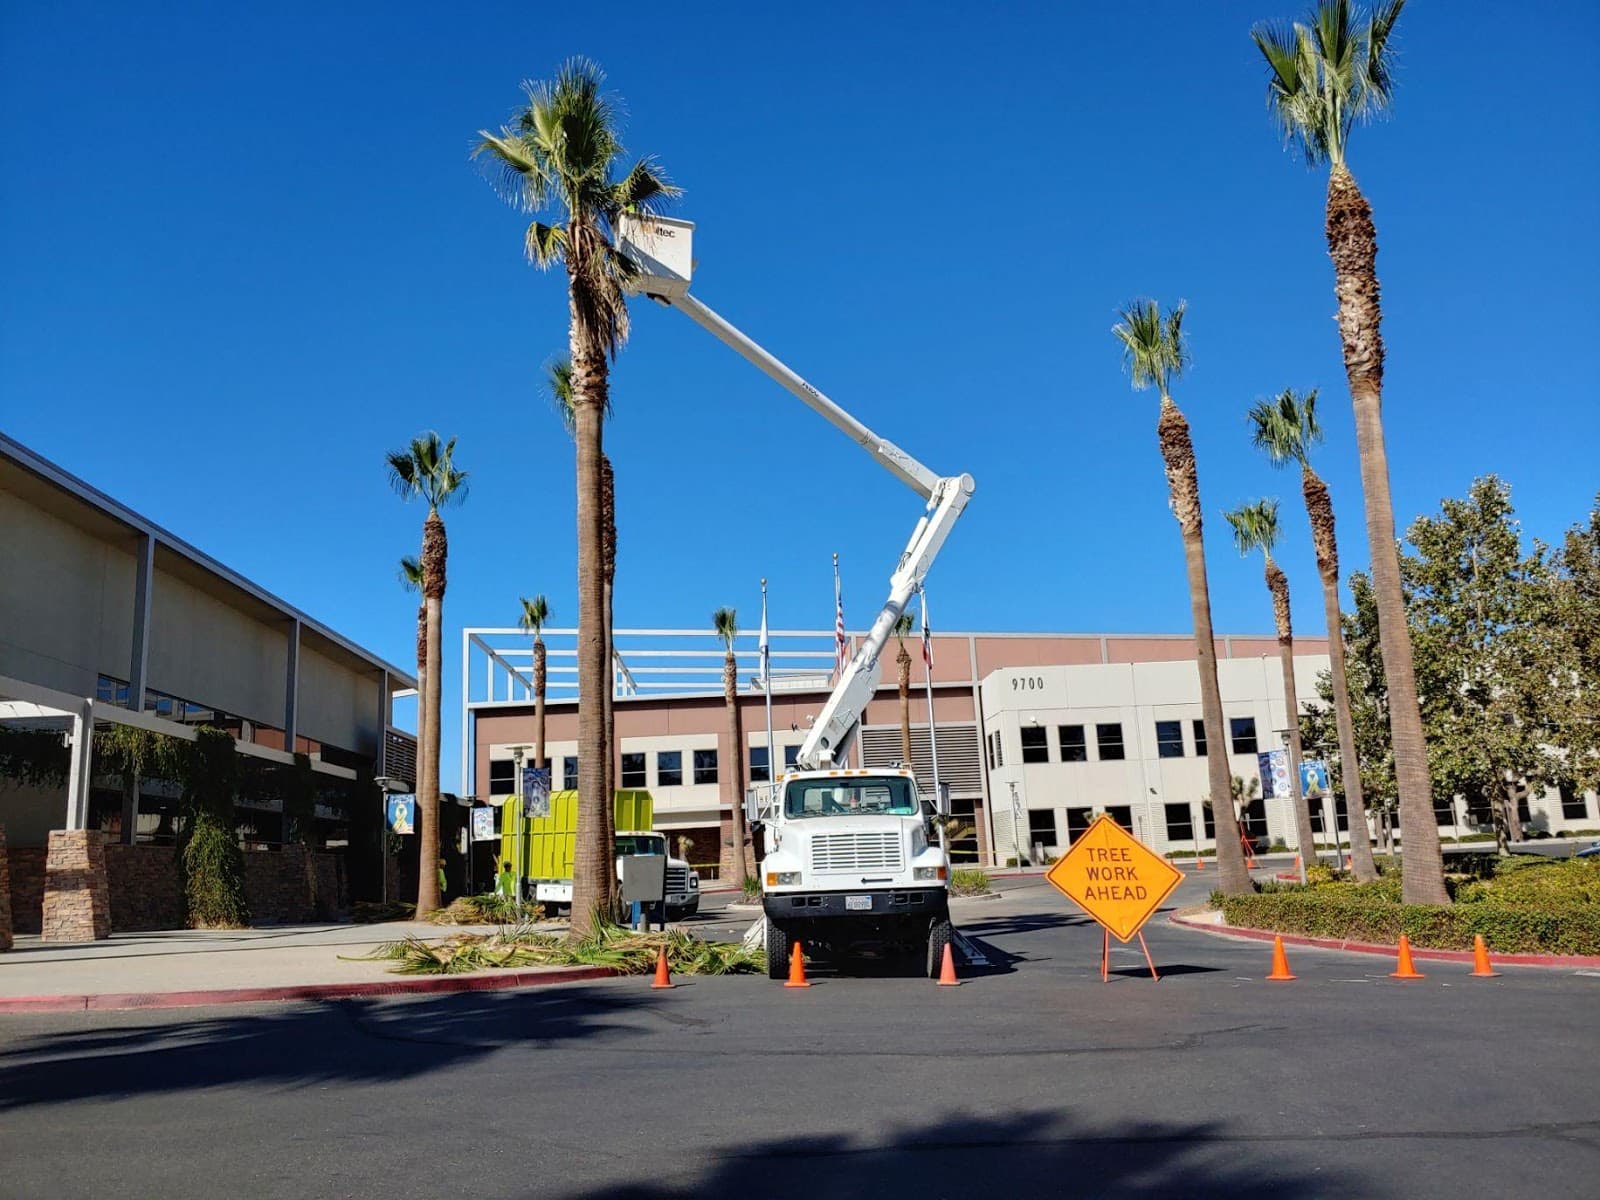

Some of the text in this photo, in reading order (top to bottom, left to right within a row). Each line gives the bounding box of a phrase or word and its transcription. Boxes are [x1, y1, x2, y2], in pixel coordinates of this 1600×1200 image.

[1012, 676, 1044, 691] 9700
[1086, 848, 1132, 862] TREE
[1086, 866, 1138, 881] WORK
[1085, 886, 1147, 900] AHEAD
